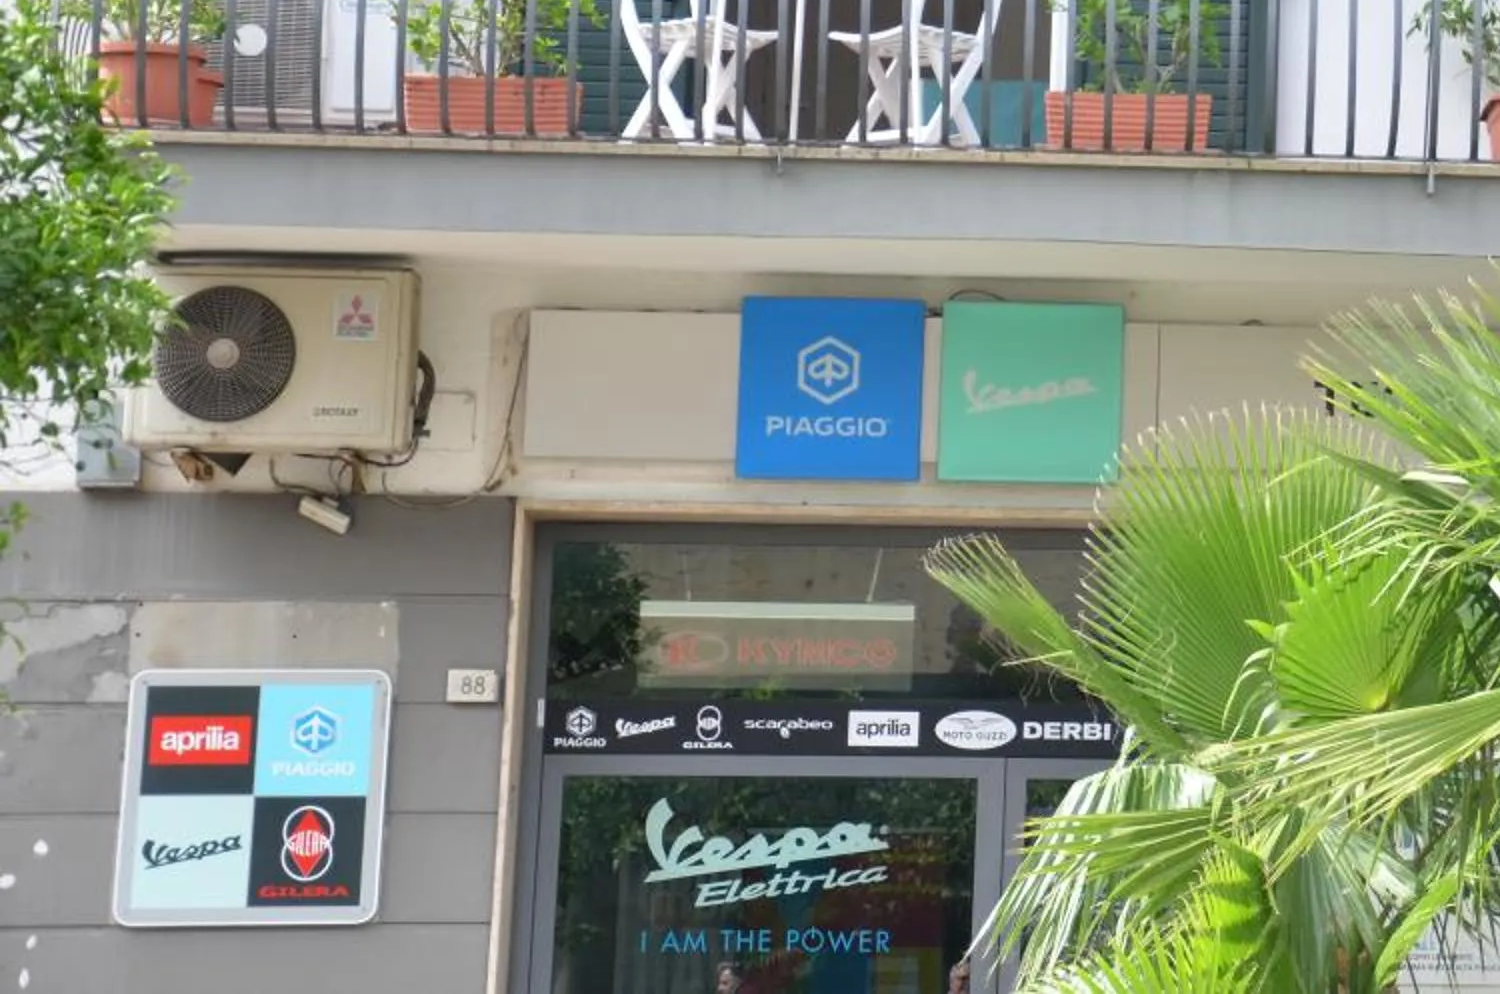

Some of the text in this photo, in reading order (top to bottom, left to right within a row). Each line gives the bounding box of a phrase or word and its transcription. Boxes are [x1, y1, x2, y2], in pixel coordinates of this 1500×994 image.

[962, 368, 1099, 414] Vespa
[766, 415, 888, 437] PIAGGIO
[737, 637, 897, 668] KYMCO
[461, 675, 486, 695] 88
[615, 715, 678, 738] Vespa
[743, 717, 834, 738] scarabeo
[855, 718, 912, 738] aprilia
[943, 730, 1010, 742] MOTO GUZZI
[1022, 721, 1113, 742] DERBI
[160, 725, 240, 755] aprilia
[553, 737, 608, 747] PIAGGIO
[682, 740, 733, 749] GILERA
[272, 762, 356, 777] PIAGGIO
[287, 828, 331, 857] GILERA
[643, 797, 890, 883] Vespa
[142, 835, 242, 870] Vespa
[258, 885, 350, 898] GILERA
[693, 865, 889, 908] Elettrica
[639, 925, 891, 954] I AM THE POWER
